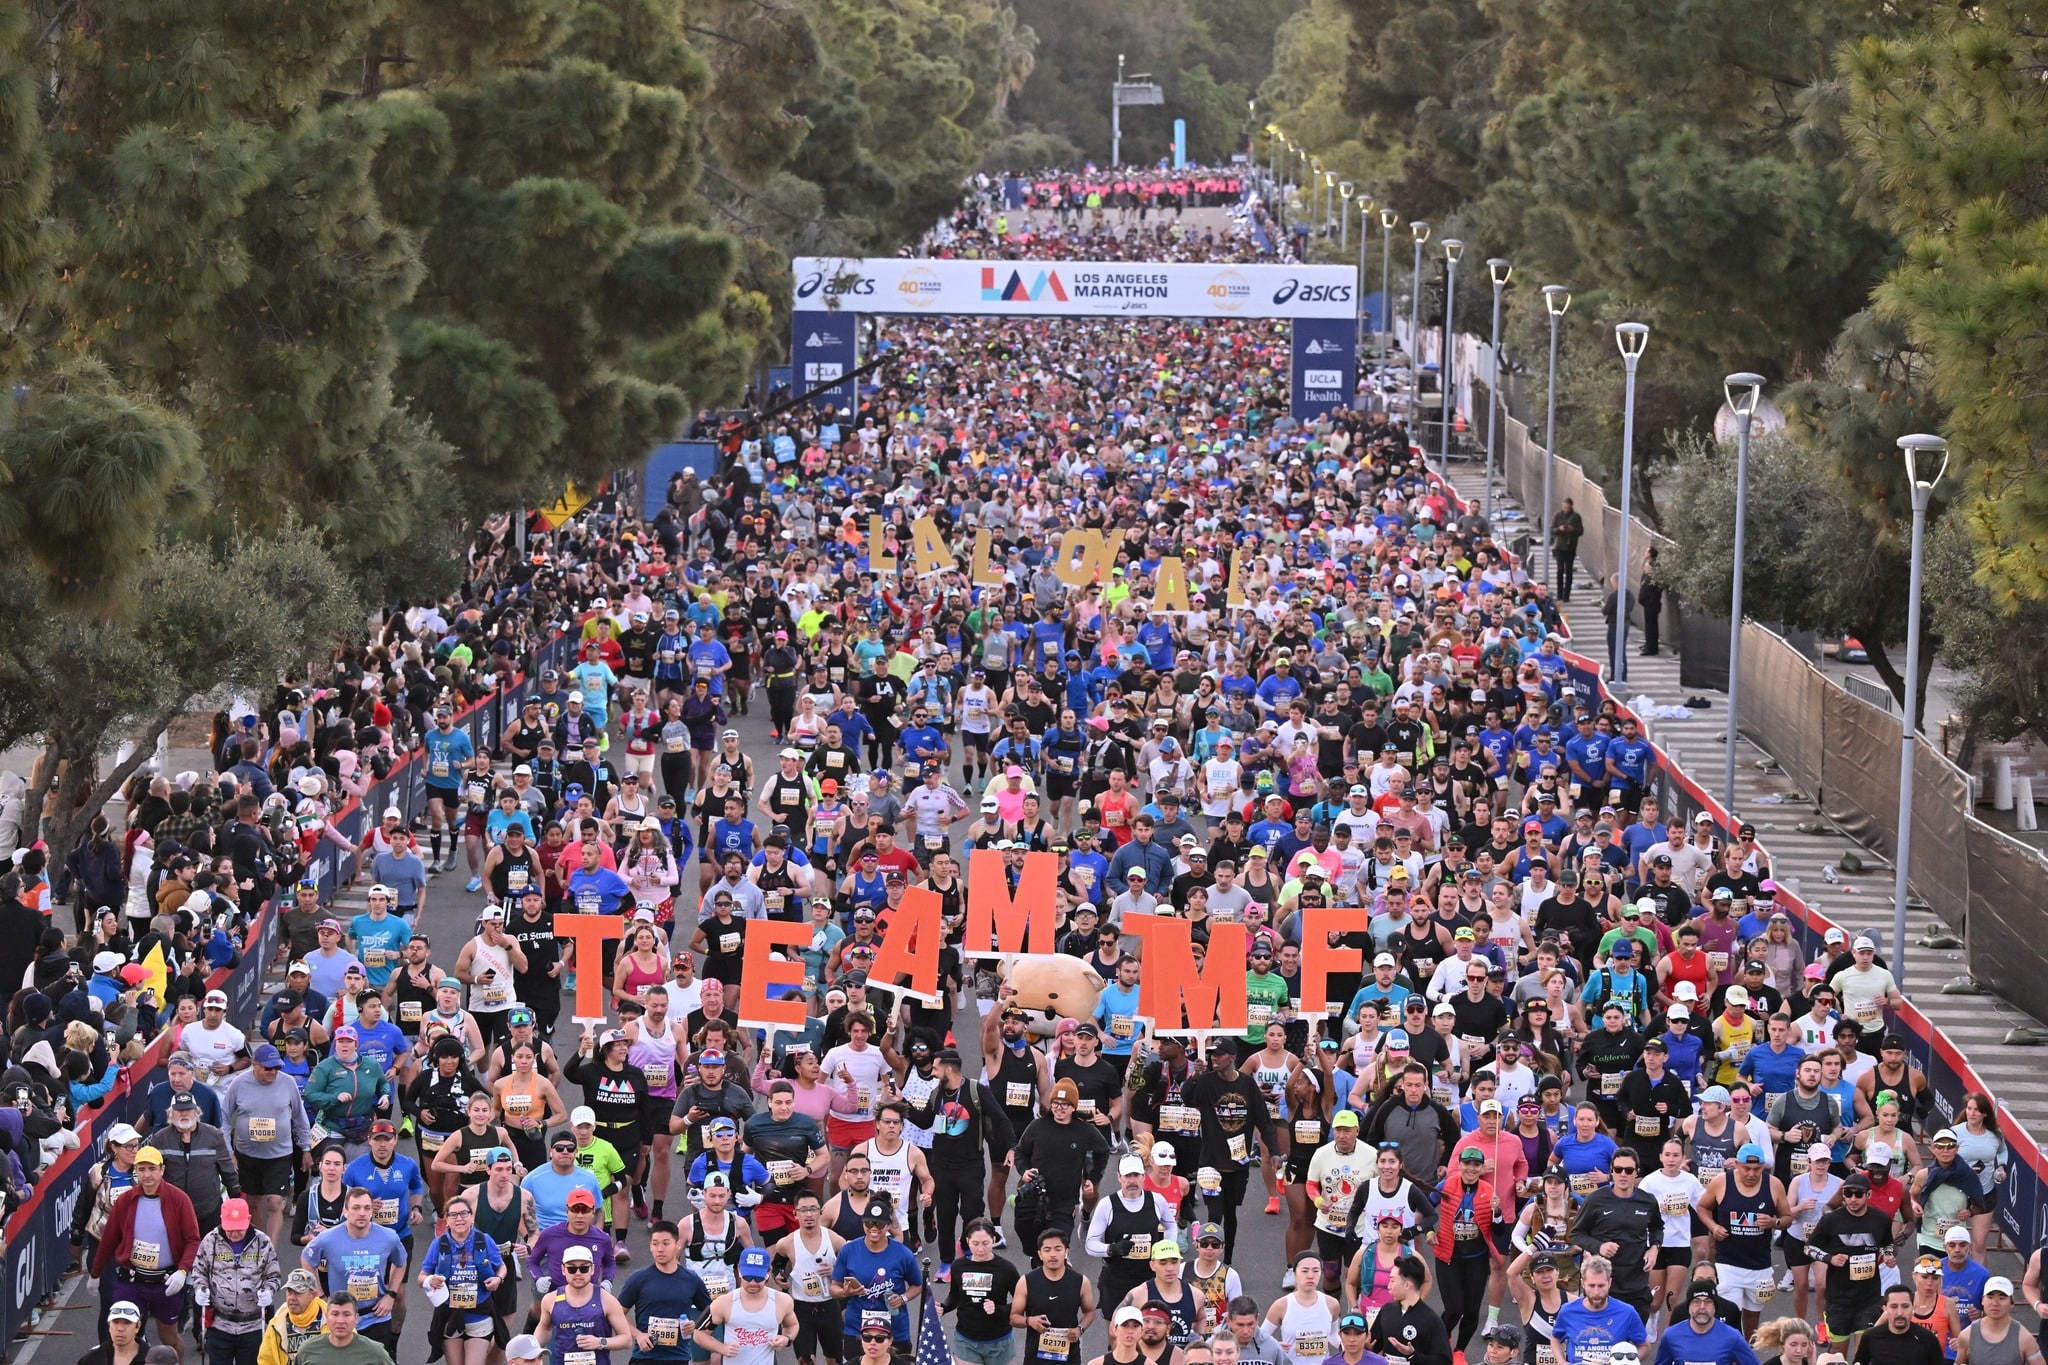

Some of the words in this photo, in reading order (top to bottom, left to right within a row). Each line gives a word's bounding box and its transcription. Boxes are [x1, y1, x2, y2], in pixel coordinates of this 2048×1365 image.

[1074, 274, 1099, 284] LOS
[1105, 274, 1168, 284] ANGELES
[898, 281, 918, 294] 40
[1074, 285, 1168, 298] MARATHON
[1207, 285, 1227, 298] 40
[810, 366, 837, 377] UCLA
[1310, 374, 1337, 384] UCLA
[1304, 390, 1342, 402] Health
[876, 682, 894, 695] LA
[1212, 770, 1231, 778] BEER
[1258, 1072, 1279, 1082] RUN
[597, 1091, 609, 1099] LOS
[597, 1096, 636, 1104] MARATHON
[374, 1211, 397, 1219] 26780
[15, 1235, 37, 1310] GU
[1853, 1266, 1873, 1274] 18128
[865, 1279, 895, 1299] odgers
